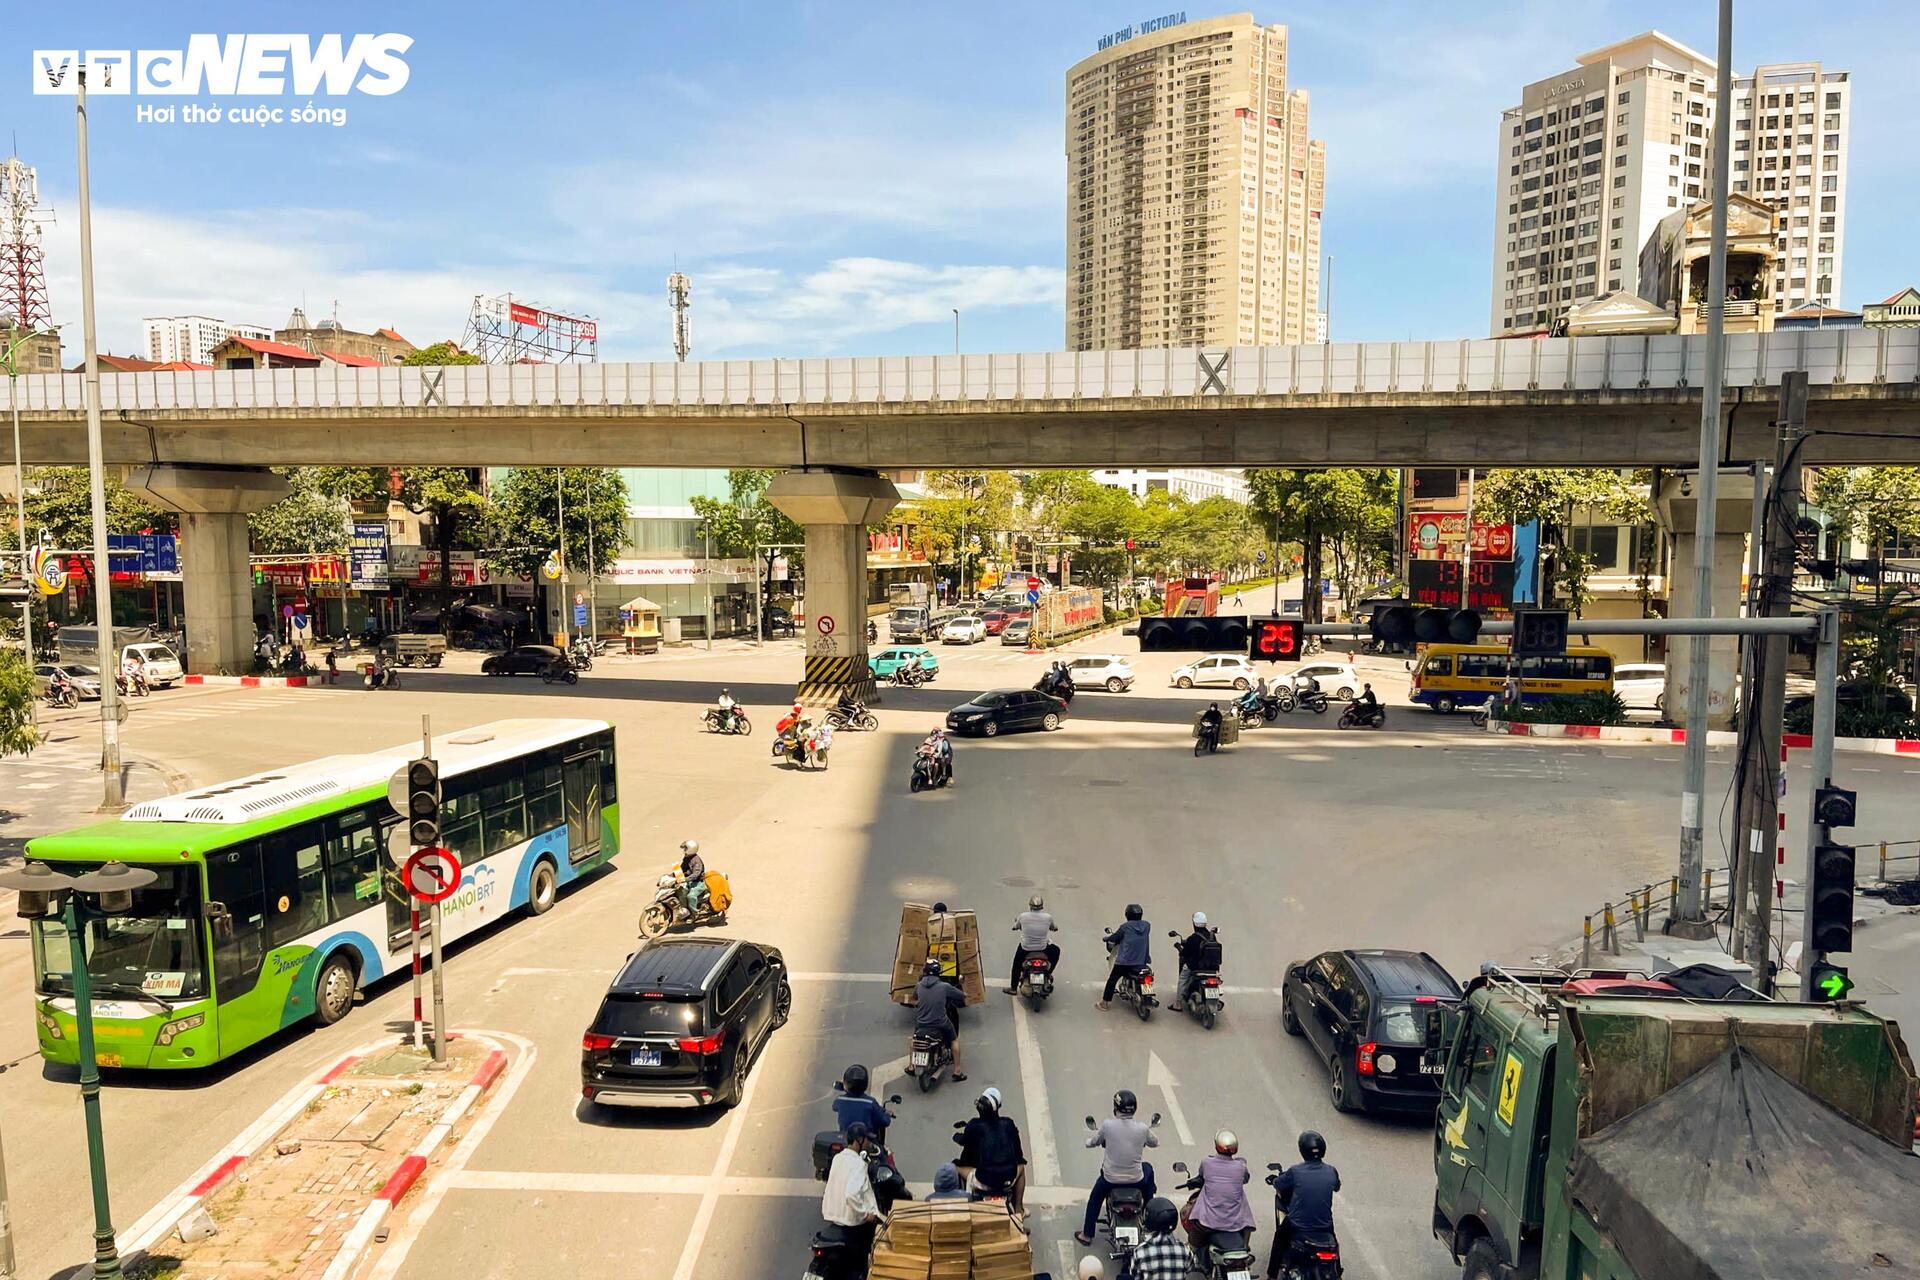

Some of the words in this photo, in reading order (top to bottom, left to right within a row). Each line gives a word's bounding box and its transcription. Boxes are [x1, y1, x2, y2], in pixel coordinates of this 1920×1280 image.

[1115, 25, 1132, 45] PHÚ
[1141, 11, 1187, 35] VICTORIA
[1261, 625, 1293, 653] 25
[146, 980, 164, 990] KIM
